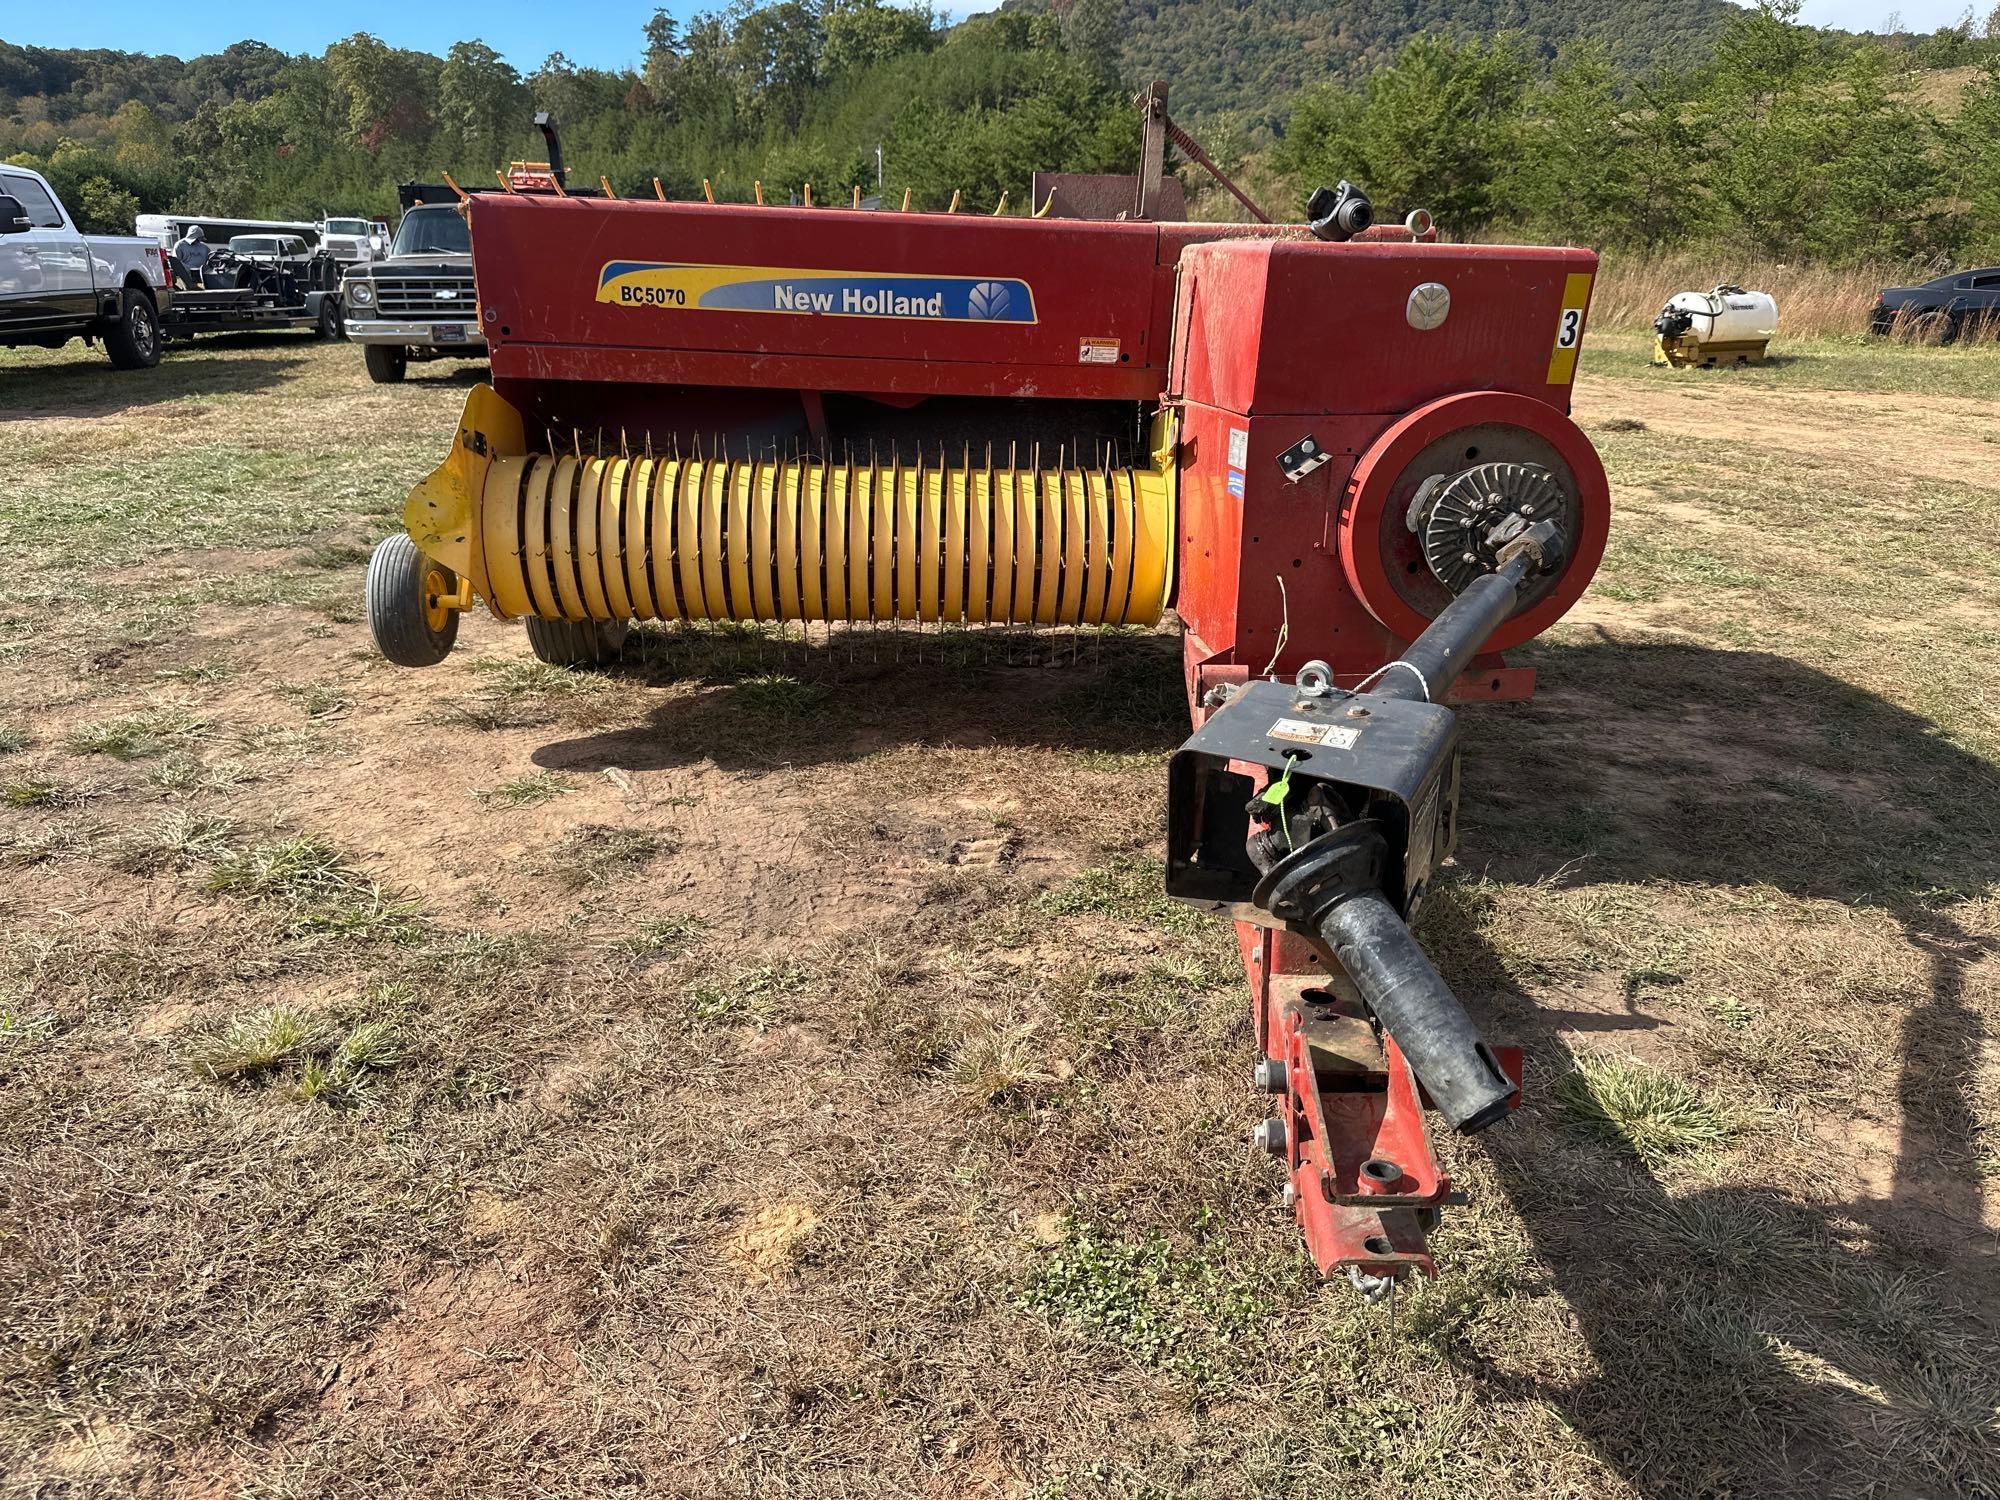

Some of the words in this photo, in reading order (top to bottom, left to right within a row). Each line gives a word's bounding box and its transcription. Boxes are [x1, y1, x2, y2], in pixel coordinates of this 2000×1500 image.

[620, 285, 686, 306] BC5070
[774, 285, 834, 312] New
[842, 288, 943, 317] Holland
[1559, 310, 1579, 347] 3
